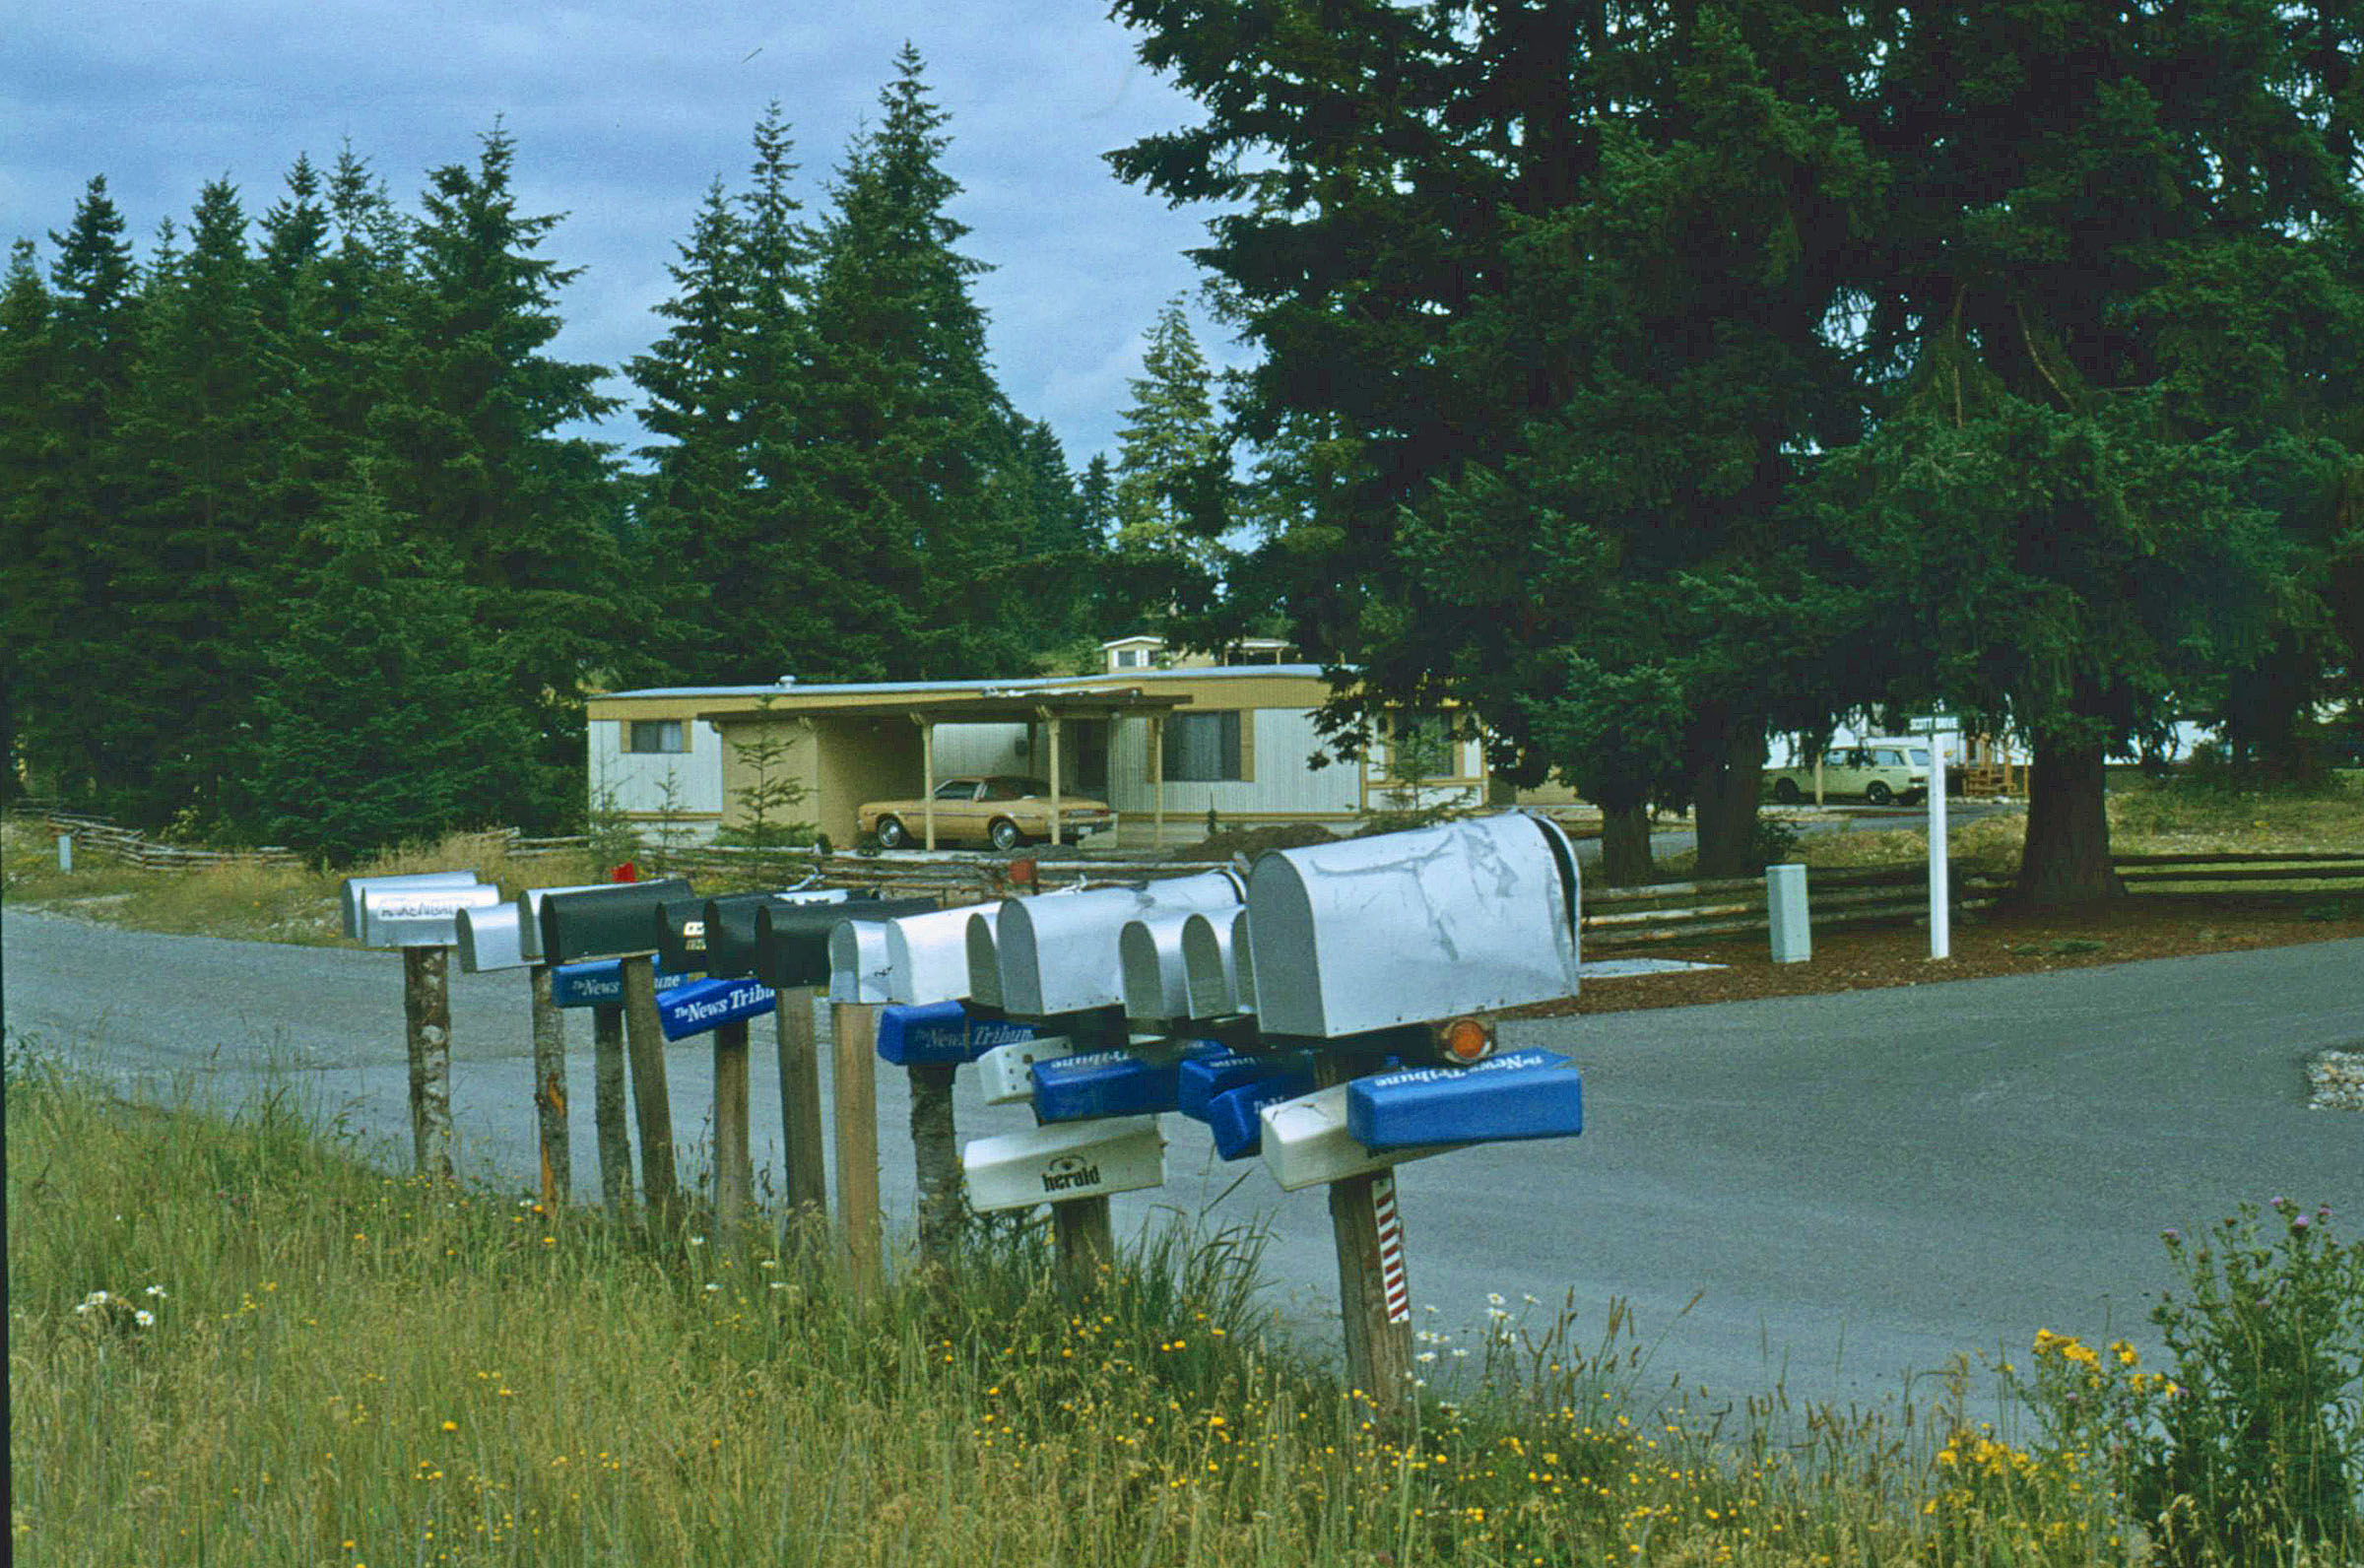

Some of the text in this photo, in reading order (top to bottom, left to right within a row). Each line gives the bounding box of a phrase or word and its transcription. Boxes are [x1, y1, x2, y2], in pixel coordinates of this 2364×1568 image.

[581, 978, 622, 997] News
[688, 999, 728, 1022] News
[730, 983, 775, 1010] Tribu
[1375, 1069, 1467, 1086] Tribune
[1042, 1164, 1101, 1193] herald
